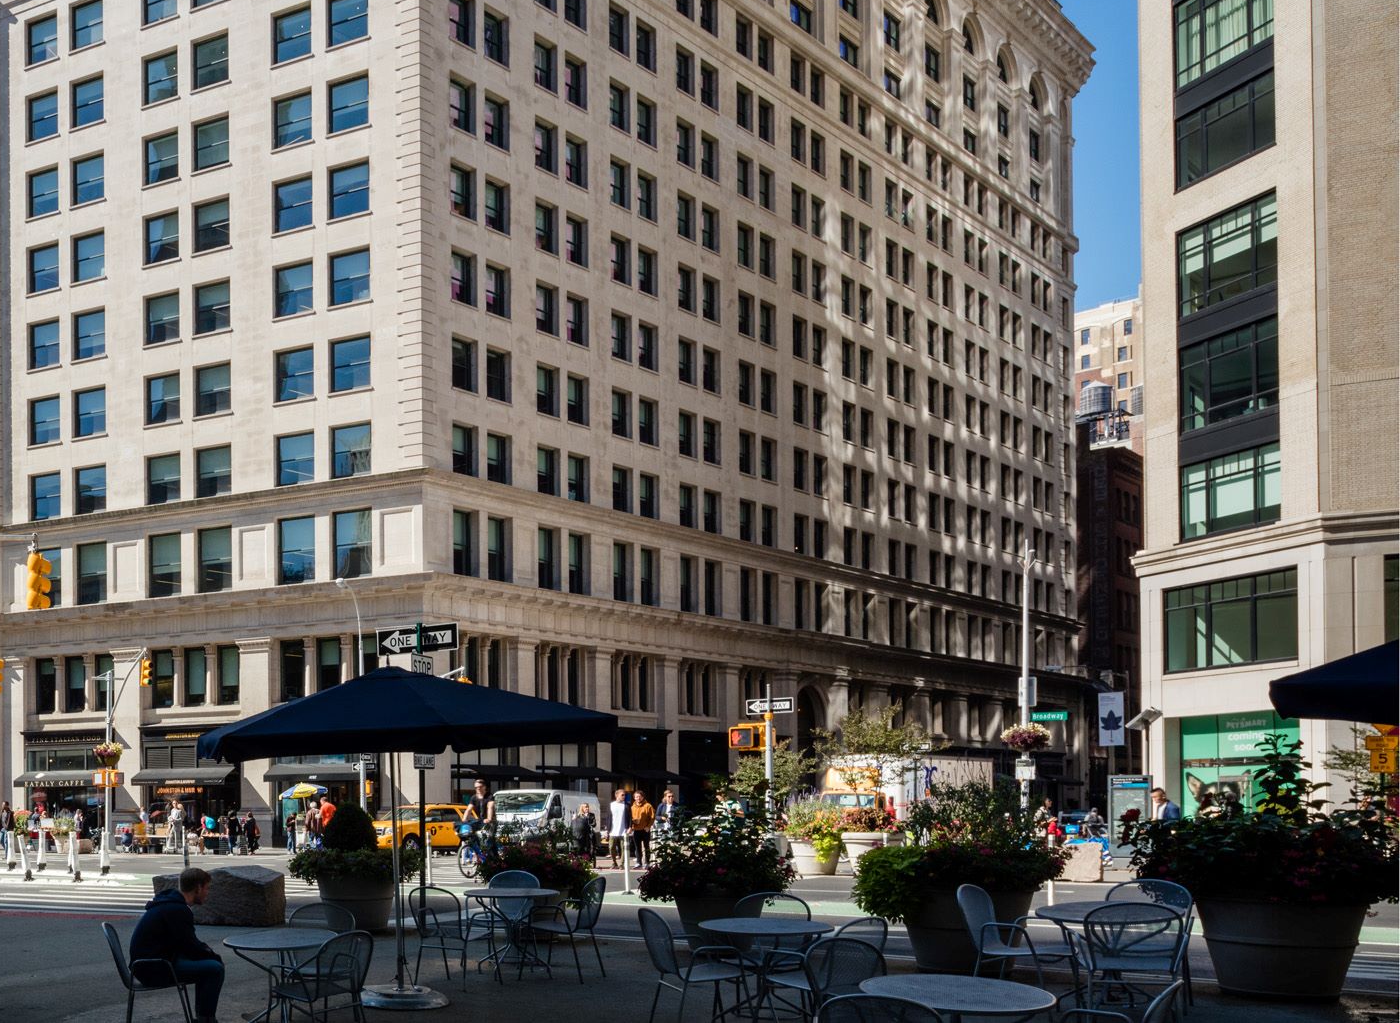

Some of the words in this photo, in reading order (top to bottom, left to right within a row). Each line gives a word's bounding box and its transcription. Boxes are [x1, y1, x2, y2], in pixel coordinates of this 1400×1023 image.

[389, 635, 412, 647] ONE
[423, 632, 447, 645] WAY
[413, 660, 432, 675] STOP
[1228, 731, 1265, 742] coming
[1378, 753, 1388, 764] 5
